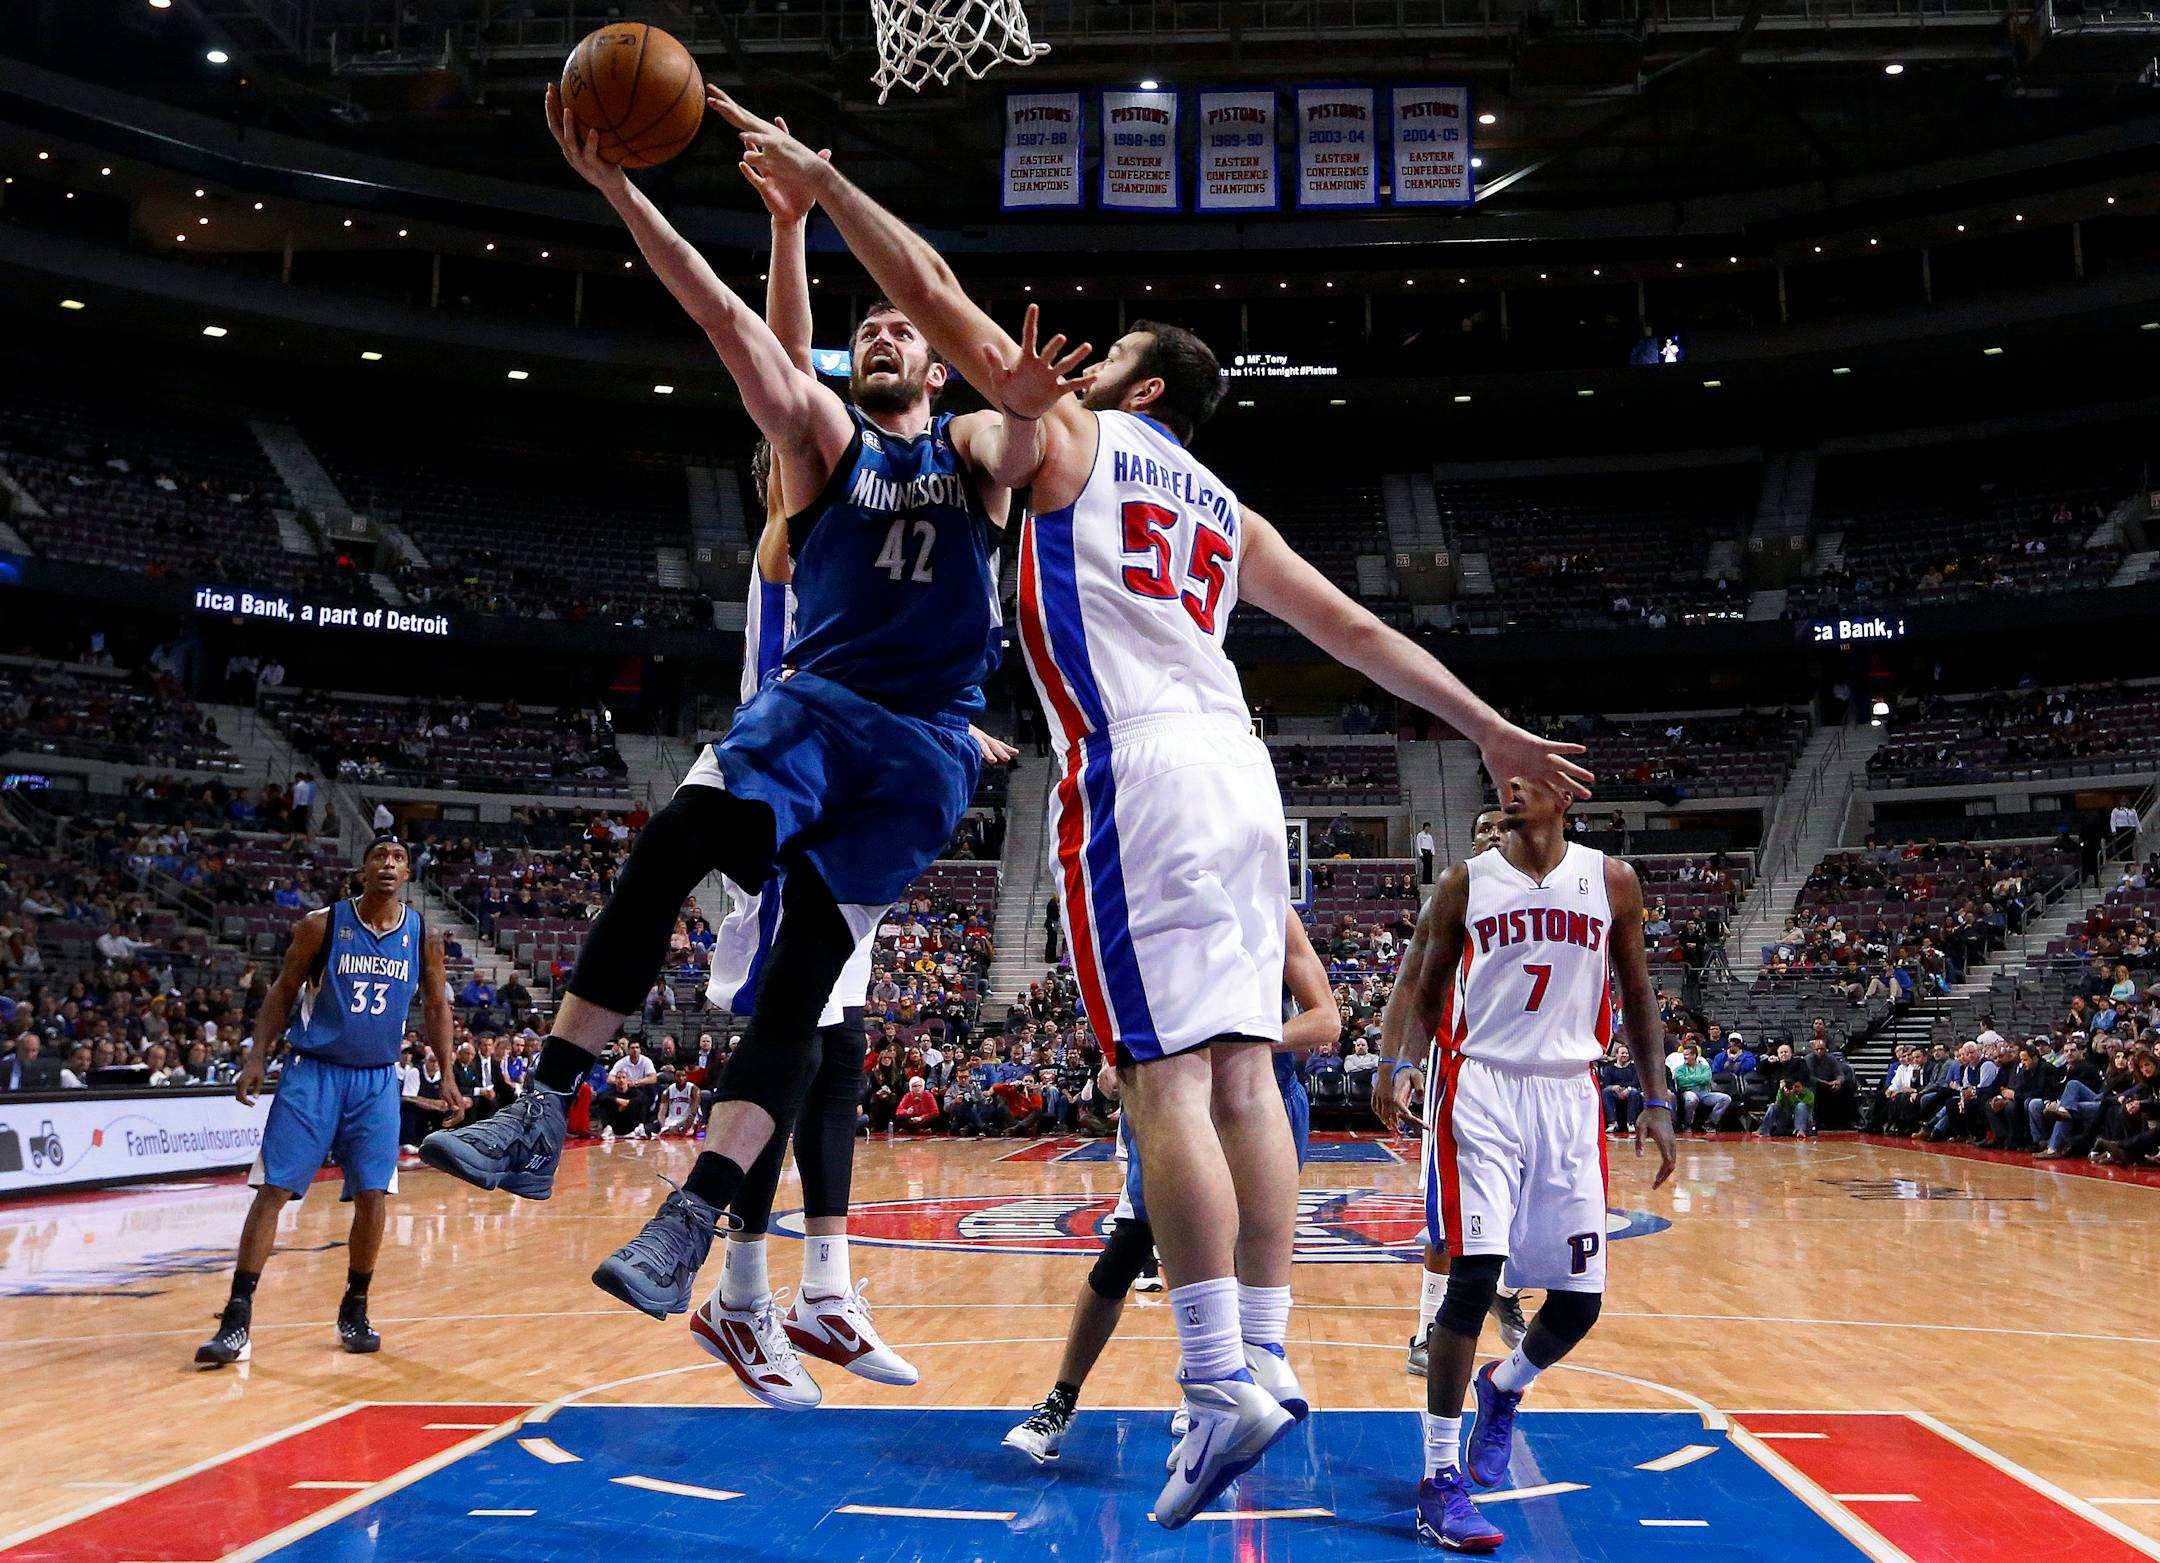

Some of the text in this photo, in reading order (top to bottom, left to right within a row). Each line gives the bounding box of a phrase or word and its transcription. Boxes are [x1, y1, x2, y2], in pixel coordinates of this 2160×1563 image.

[1014, 107, 1071, 124] PISTONS
[1110, 107, 1169, 125] PISTONS
[1208, 107, 1266, 125] PISTONS
[1307, 103, 1366, 122] PISTONS
[1401, 101, 1459, 120] PISTONS
[1016, 133, 1067, 145] 1987-88
[1113, 134, 1166, 147] 1988-89
[1211, 134, 1263, 147] 1989-90
[1308, 130, 1365, 144] 2003-04
[1403, 129, 1459, 142] 2004-05
[1019, 155, 1063, 165] EASTERN
[1117, 156, 1162, 167] EASTERN
[1215, 157, 1259, 167] EASTERN
[1314, 153, 1360, 163] EASTERN
[1409, 152, 1454, 162] EASTERN
[1010, 168, 1072, 178] CONFERENCE
[1108, 170, 1170, 180] CONFERENCE
[1207, 170, 1268, 180] CONFERENCE
[1306, 167, 1369, 177] CONFERENCE
[1402, 165, 1464, 176] CONFERENCE
[1013, 181, 1069, 192] CHAMPIONS
[1111, 183, 1167, 194] CHAMPIONS
[1210, 184, 1265, 194] CHAMPIONS
[1309, 181, 1366, 191] CHAMPIONS
[1404, 179, 1461, 190] CHAMPIONS
[1231, 367, 1241, 376] be
[1243, 367, 1266, 376] 11-11
[1267, 366, 1299, 377] tonight
[1300, 366, 1337, 375] #Pistons
[847, 468, 969, 512] MINNESOTA
[874, 519, 937, 583] 42
[1121, 500, 1233, 635] 55
[195, 588, 235, 612] rica
[241, 593, 295, 623] Bank,
[301, 605, 313, 621] a
[319, 606, 358, 626] part
[362, 609, 382, 628] of
[387, 611, 448, 635] Detroit
[1839, 618, 1892, 639] Bank,
[1472, 908, 1604, 954] PISTONS
[337, 952, 409, 982] MINNESOTA
[1523, 964, 1552, 1012] 7
[350, 980, 390, 1015] 33
